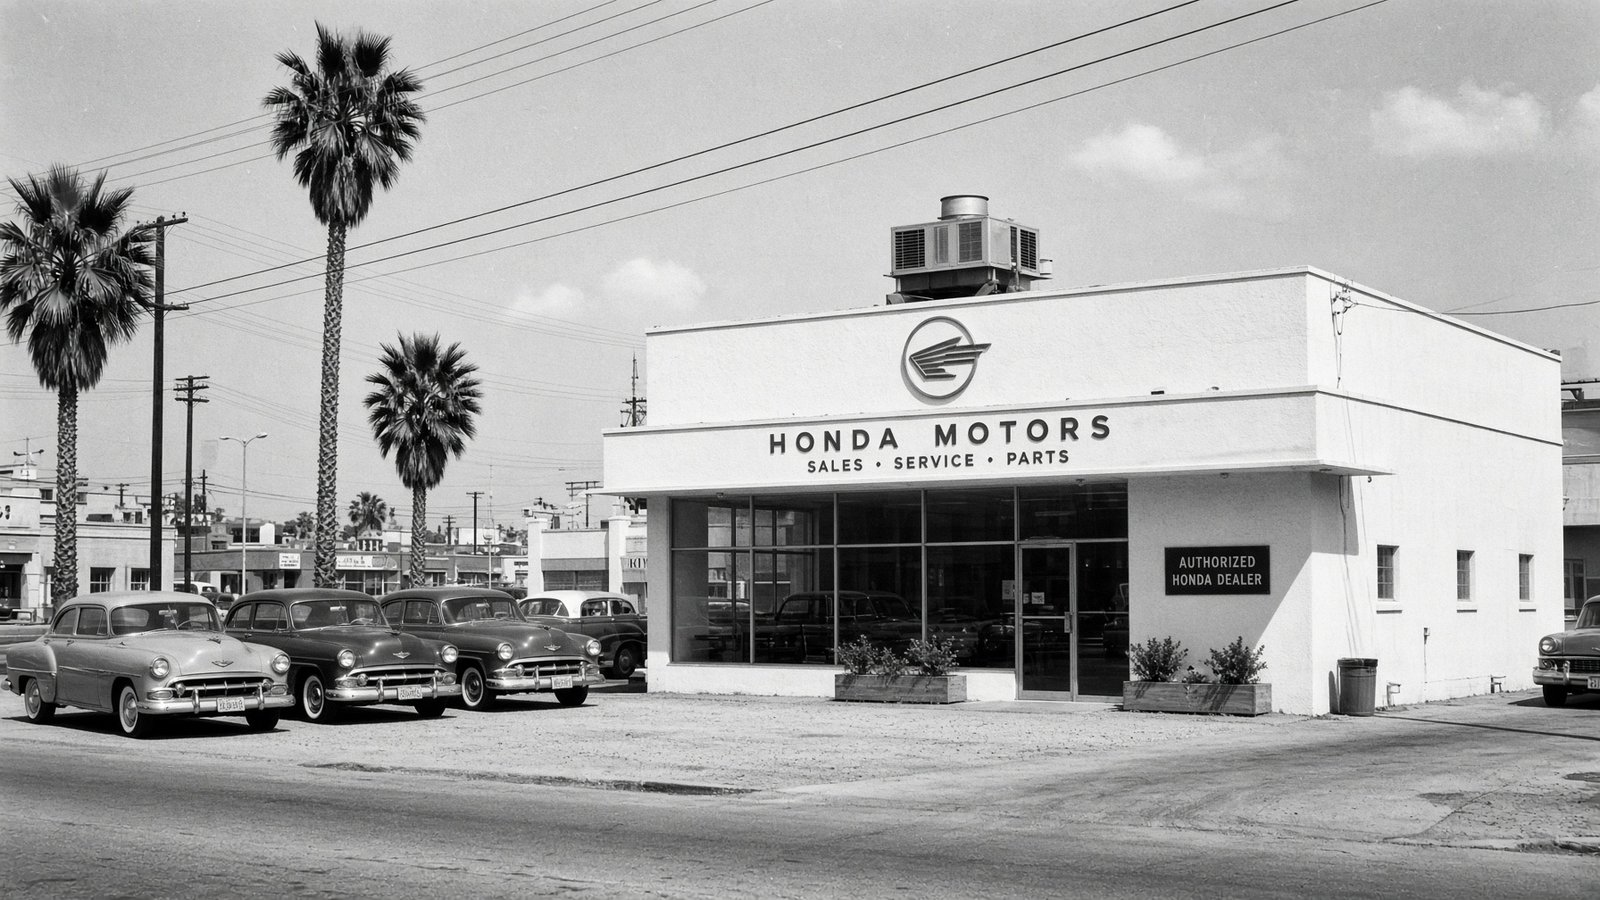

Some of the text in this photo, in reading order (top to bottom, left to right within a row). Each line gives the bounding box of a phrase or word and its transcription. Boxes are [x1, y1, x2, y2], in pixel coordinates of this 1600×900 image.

[769, 414, 1110, 455] HONDA MOTORS
[807, 449, 1069, 473] SALES SERVICE PARTS
[1179, 555, 1256, 569] AUTHORIZED
[1172, 573, 1262, 586] HONDA DEALER
